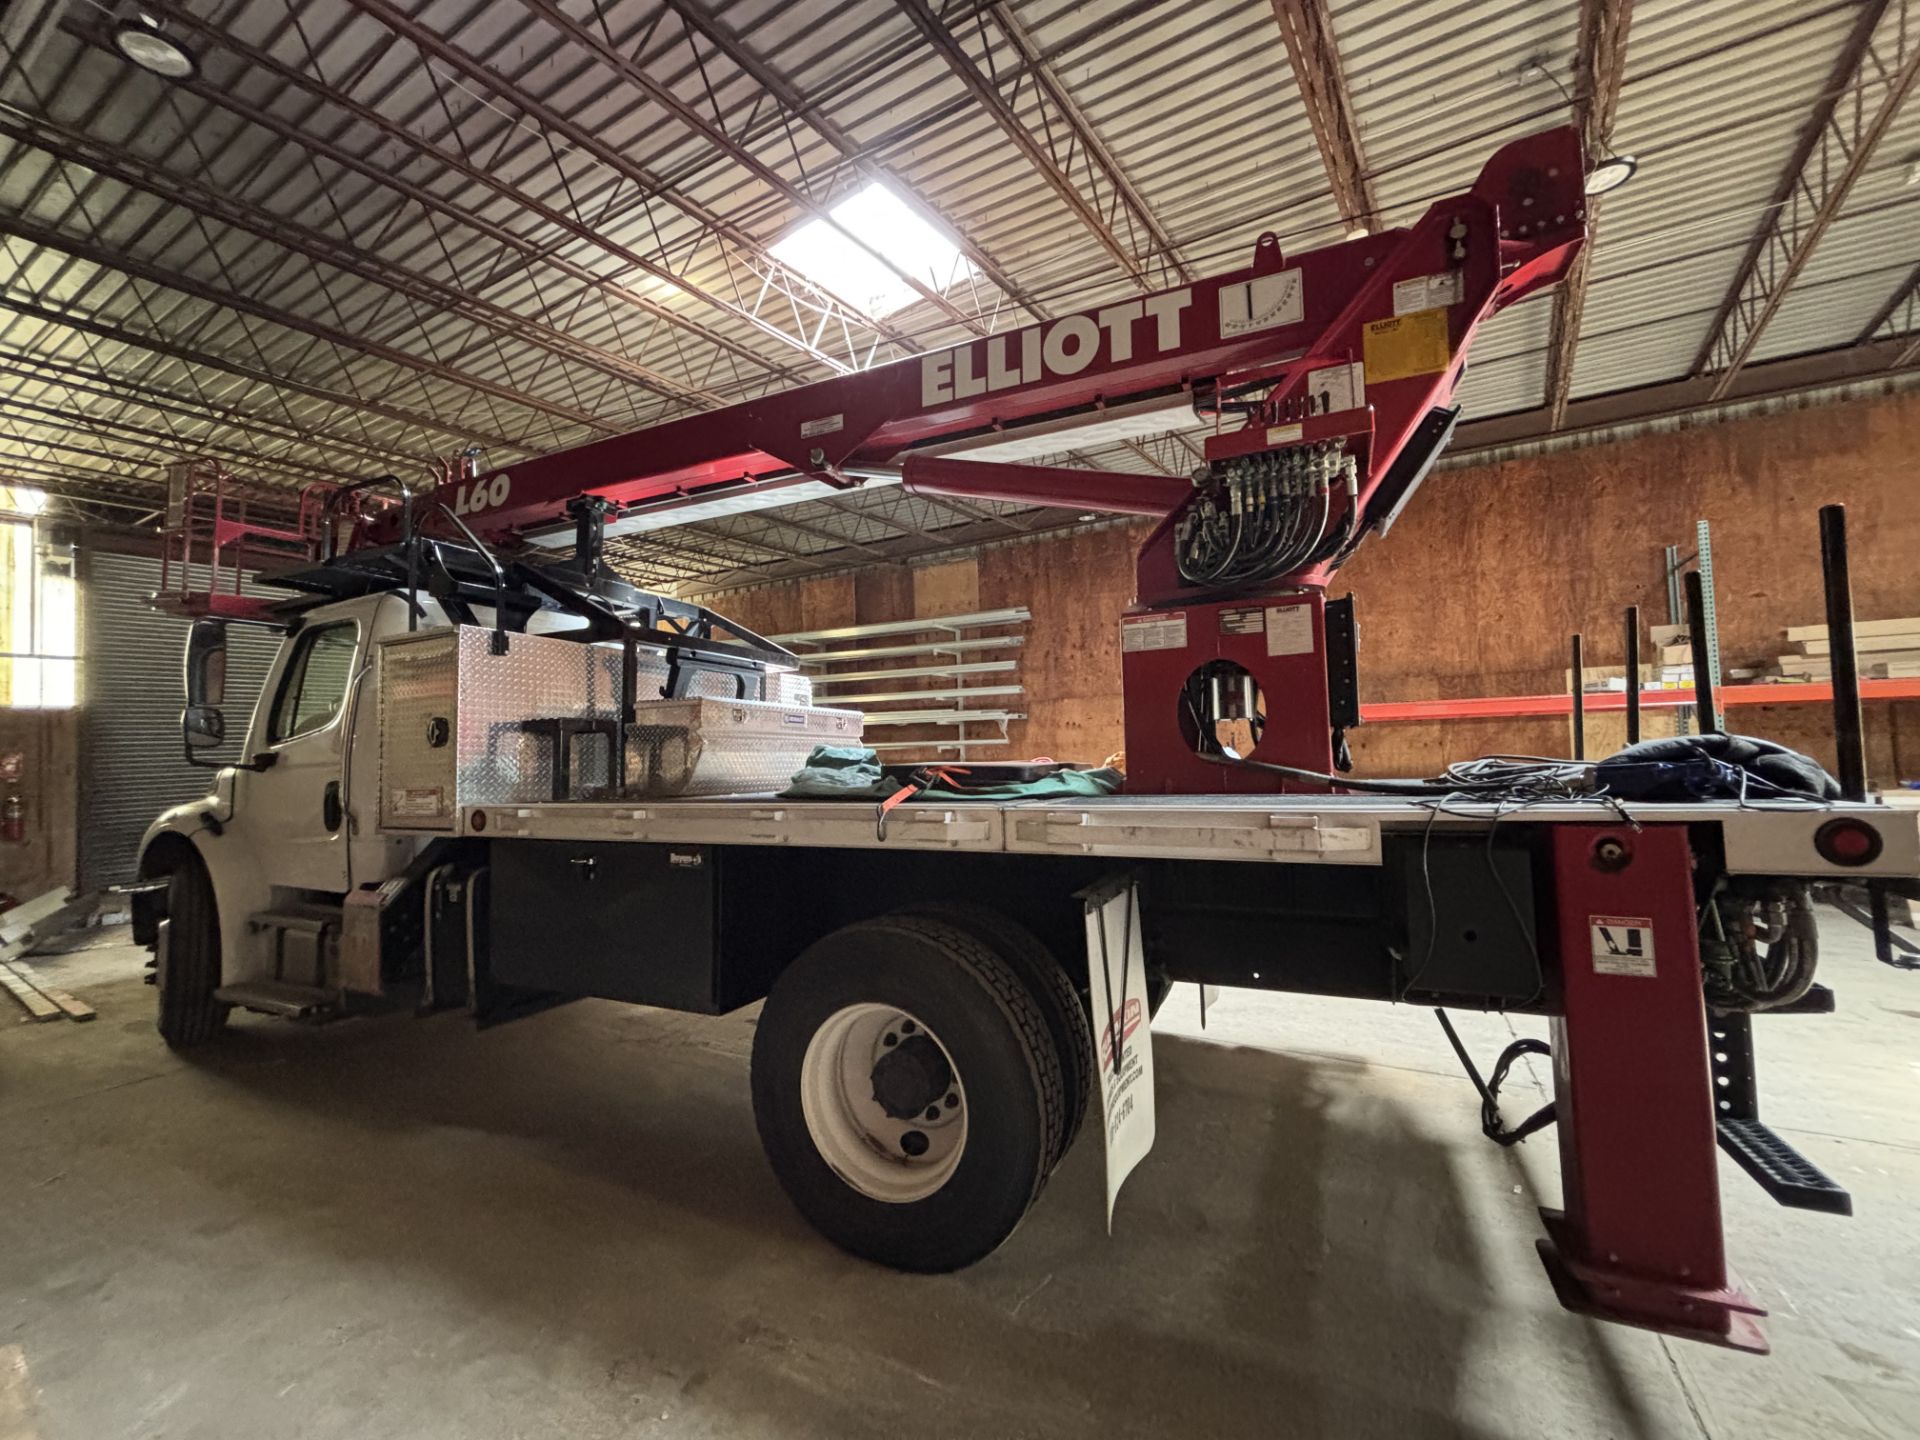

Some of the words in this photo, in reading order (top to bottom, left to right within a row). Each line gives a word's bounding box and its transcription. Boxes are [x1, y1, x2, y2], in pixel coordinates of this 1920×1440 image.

[921, 288, 1192, 408] ELLIOTT
[455, 473, 511, 517] L60
[1276, 605, 1300, 614] ELLIOTT
